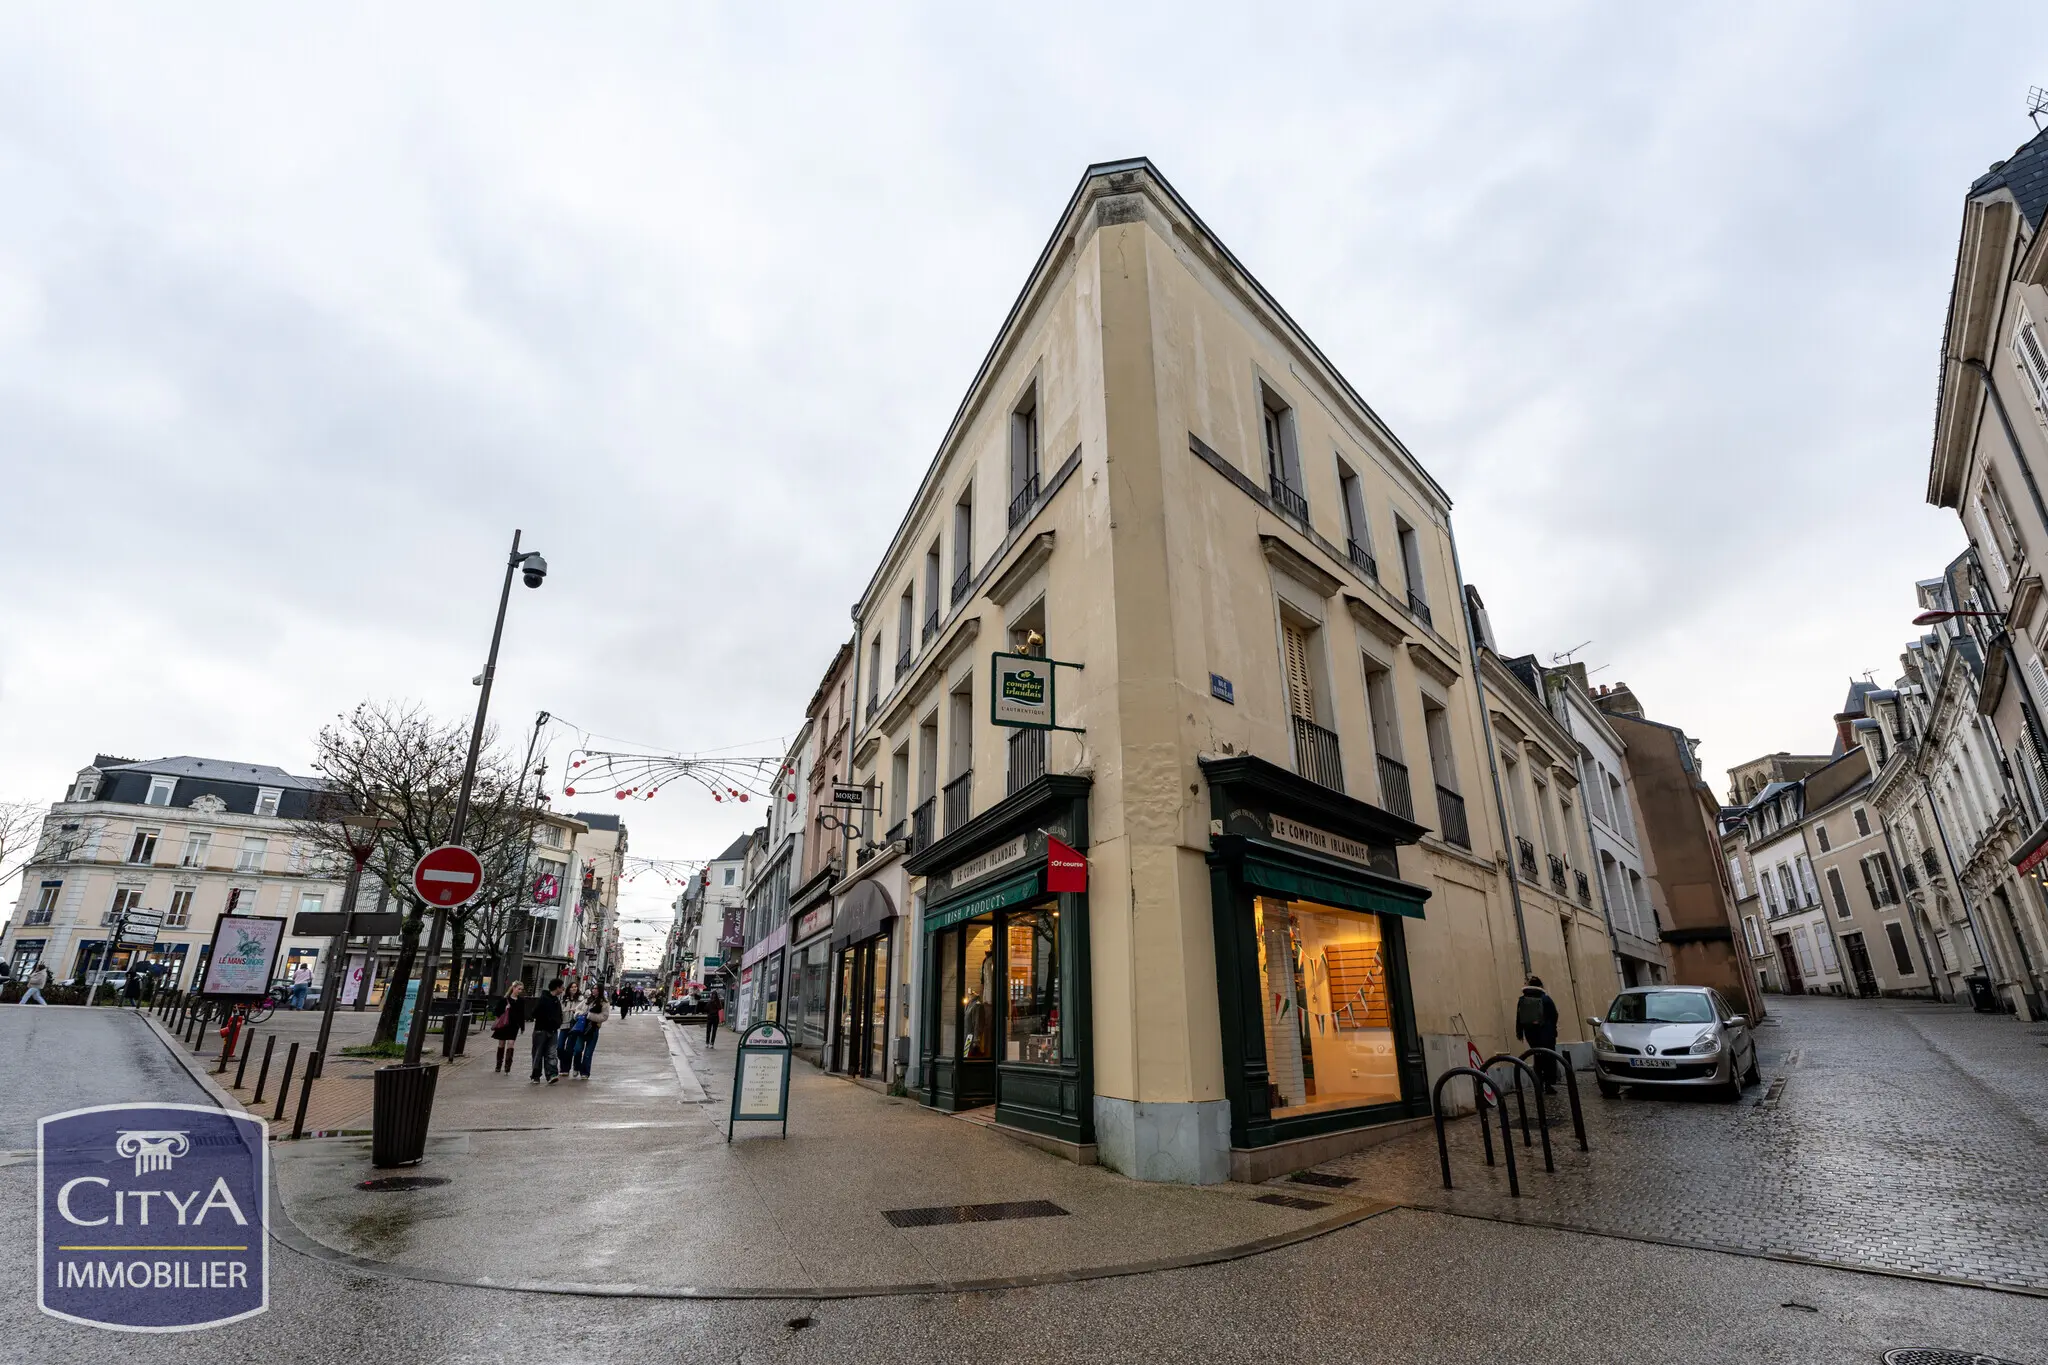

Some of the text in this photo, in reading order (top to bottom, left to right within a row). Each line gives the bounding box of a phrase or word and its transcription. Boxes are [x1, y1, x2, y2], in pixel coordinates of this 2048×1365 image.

[1006, 681, 1042, 690] comptoir
[1006, 687, 1041, 698] irlandais
[1001, 706, 1045, 716] L'AUTHENTIQUE
[836, 792, 861, 802] MOREL
[1275, 819, 1366, 860] LE COMPTOIR IRLANDAIS
[956, 842, 1017, 883] LE COMPTOIR IRLANDAIS
[1051, 860, 1062, 868] :Of
[944, 893, 1005, 925] IRISH PRODUCTS
[218, 957, 226, 965] LE
